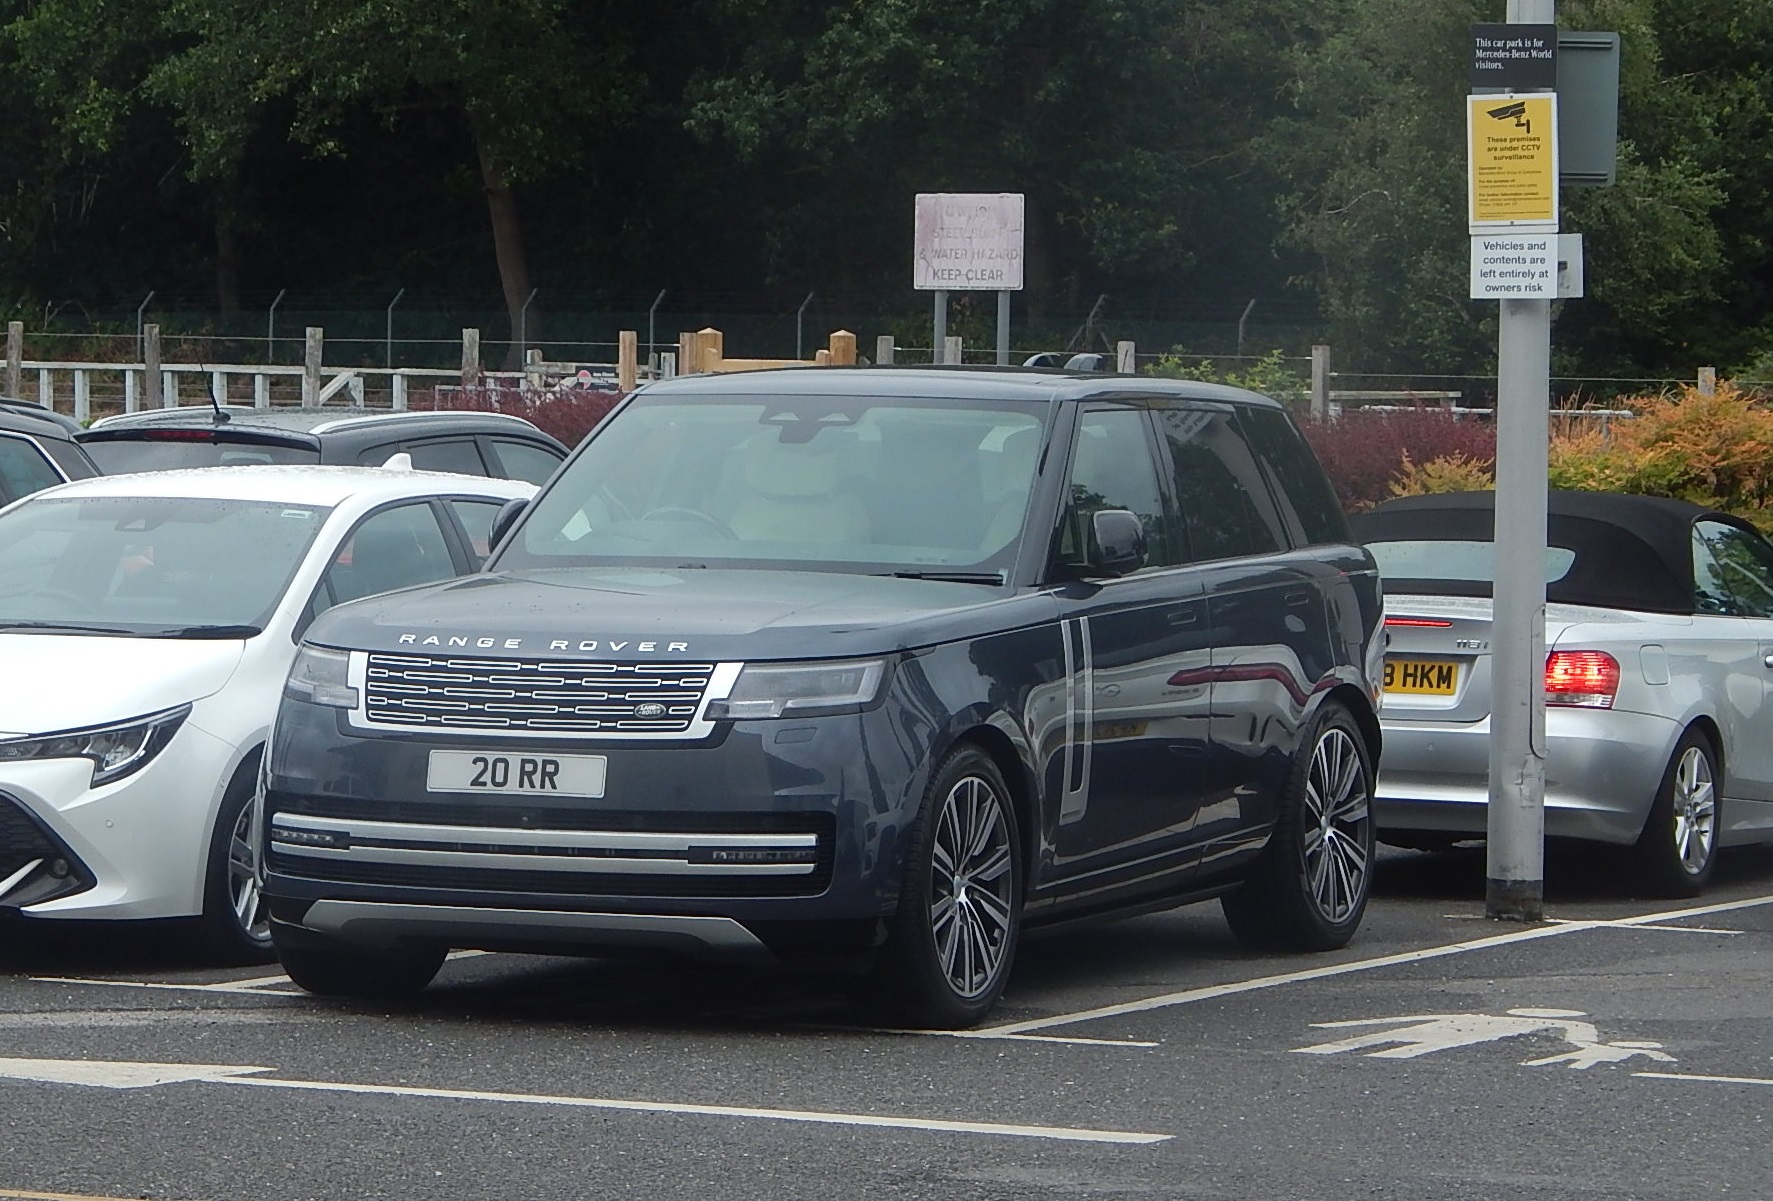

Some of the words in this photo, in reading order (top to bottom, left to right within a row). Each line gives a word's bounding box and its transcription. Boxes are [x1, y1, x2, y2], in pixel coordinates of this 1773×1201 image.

[1475, 38, 1491, 47] This
[1506, 39, 1522, 49] park
[1524, 38, 1531, 47] is
[1533, 38, 1543, 47] for
[1475, 49, 1529, 58] Mercedes-Benz
[1531, 49, 1552, 58] World
[1475, 61, 1504, 69] visitors.
[1483, 241, 1524, 250] Vehicles
[1527, 241, 1546, 250] and
[931, 248, 967, 260] WATER
[1483, 256, 1527, 264] contents
[932, 268, 961, 281] KEEP
[965, 268, 1003, 281] CLEAR
[1480, 269, 1496, 278] left
[1499, 269, 1536, 279] entirely
[1538, 269, 1549, 278] at
[1485, 284, 1521, 292] owners
[1524, 283, 1543, 292] risk
[399, 634, 522, 649] RANGE
[550, 639, 689, 653] ROVER
[1402, 663, 1453, 689] HKM
[470, 756, 510, 788] 20
[518, 758, 560, 790] RR
